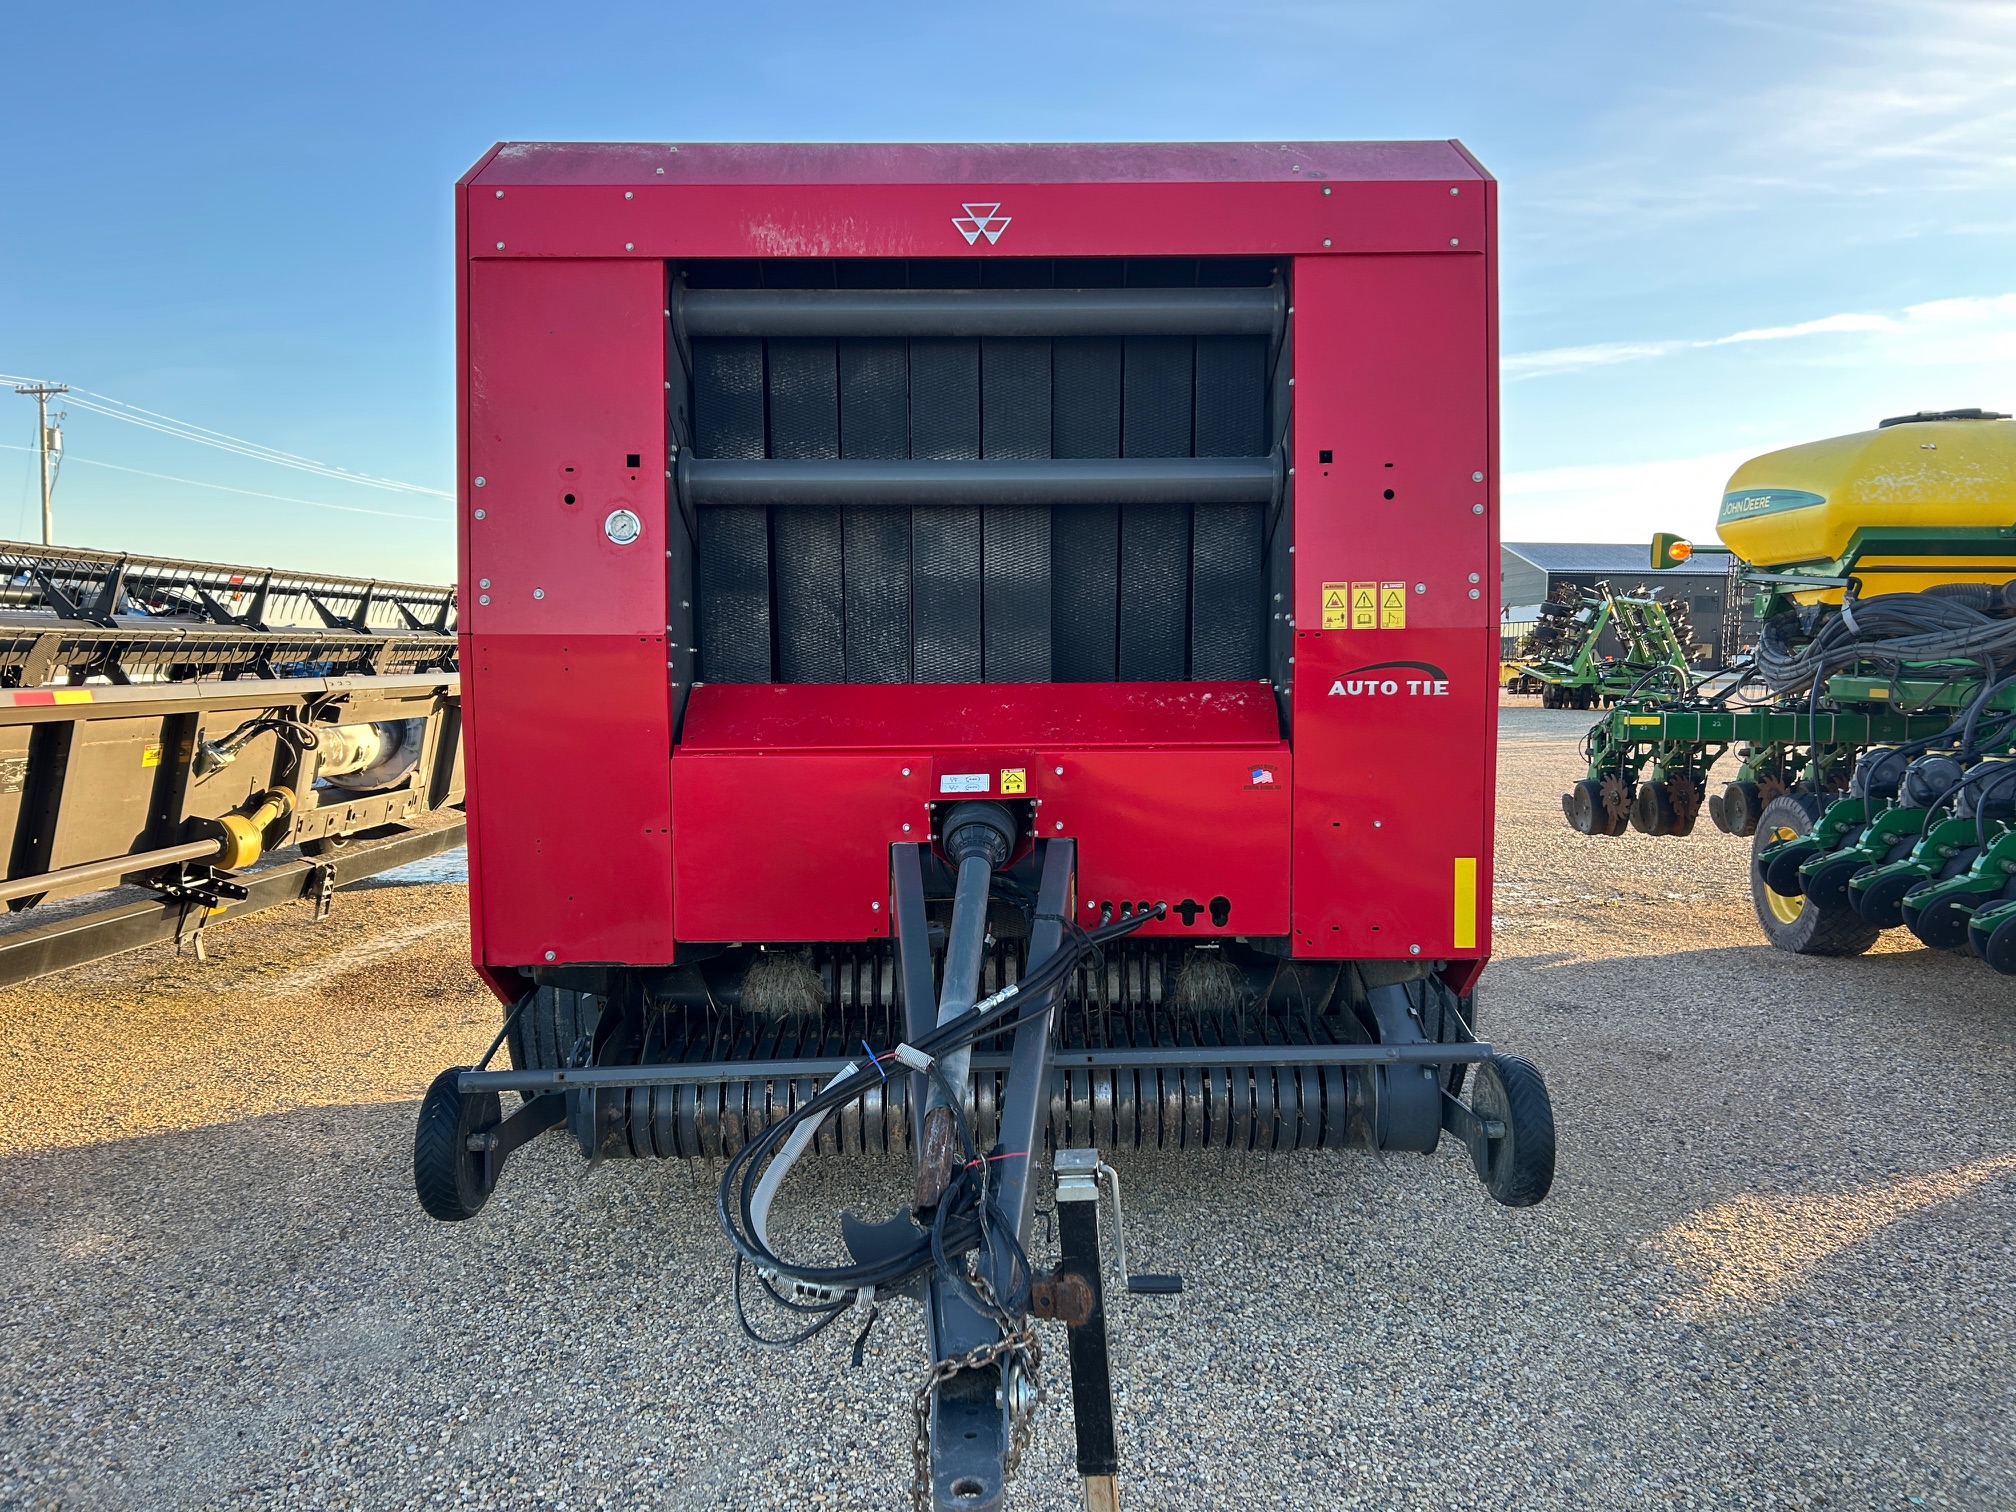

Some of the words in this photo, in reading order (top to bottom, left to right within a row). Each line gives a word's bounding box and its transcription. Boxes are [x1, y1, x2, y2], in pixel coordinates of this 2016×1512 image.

[1722, 501, 1744, 516] JOHN
[1742, 495, 1771, 512] DEERE
[1327, 680, 1398, 696] AUTO
[1406, 680, 1450, 696] TIE
